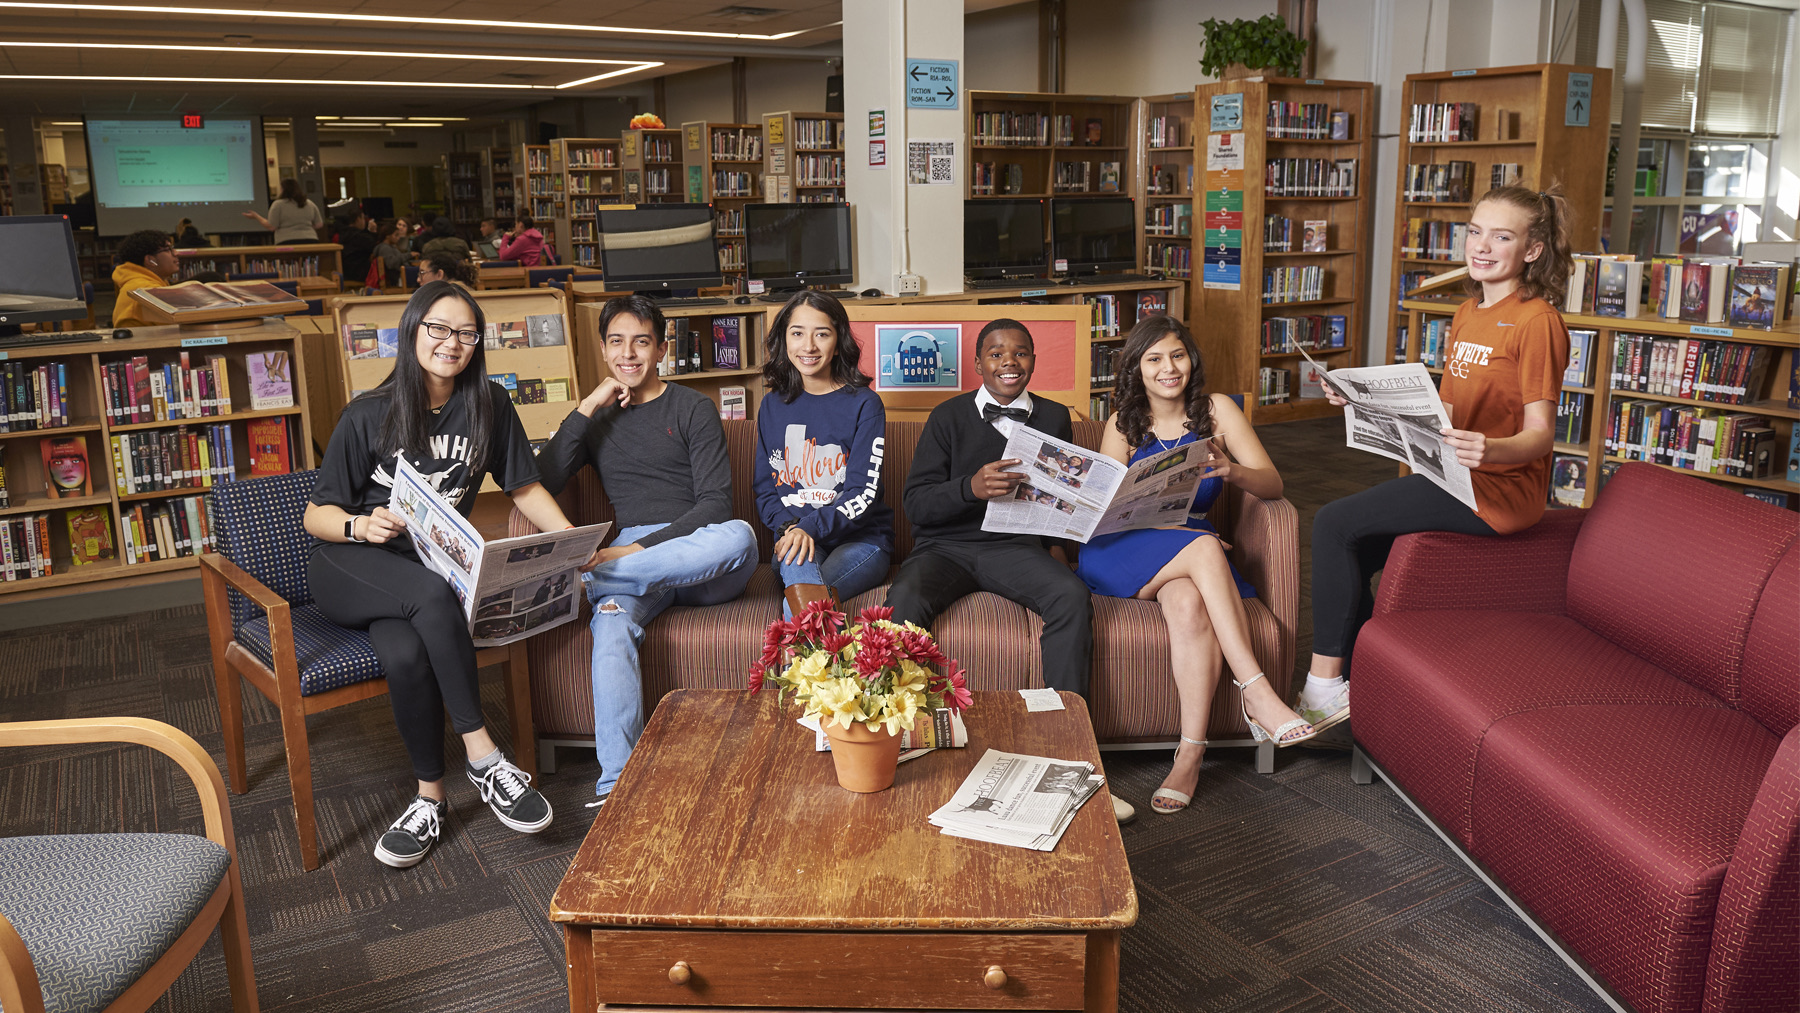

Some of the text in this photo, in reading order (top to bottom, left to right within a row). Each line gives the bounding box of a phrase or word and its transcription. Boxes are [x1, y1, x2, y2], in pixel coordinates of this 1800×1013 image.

[930, 66, 950, 74] FICTION
[184, 115, 201, 128] EXIT
[1682, 215, 1697, 233] CU
[713, 318, 738, 327] ANNE RICE
[714, 342, 738, 364] LASHER
[1455, 341, 1494, 366] WHITE
[904, 355, 934, 365] AUDIO
[904, 367, 935, 376] BOOKS
[1364, 375, 1424, 390] HOOFBEAT
[1415, 403, 1432, 411] event
[1557, 401, 1582, 417] RAZY
[255, 435, 281, 444] FORTRESS
[811, 490, 835, 501] 1964
[973, 756, 1011, 798] HOOFBEAT
